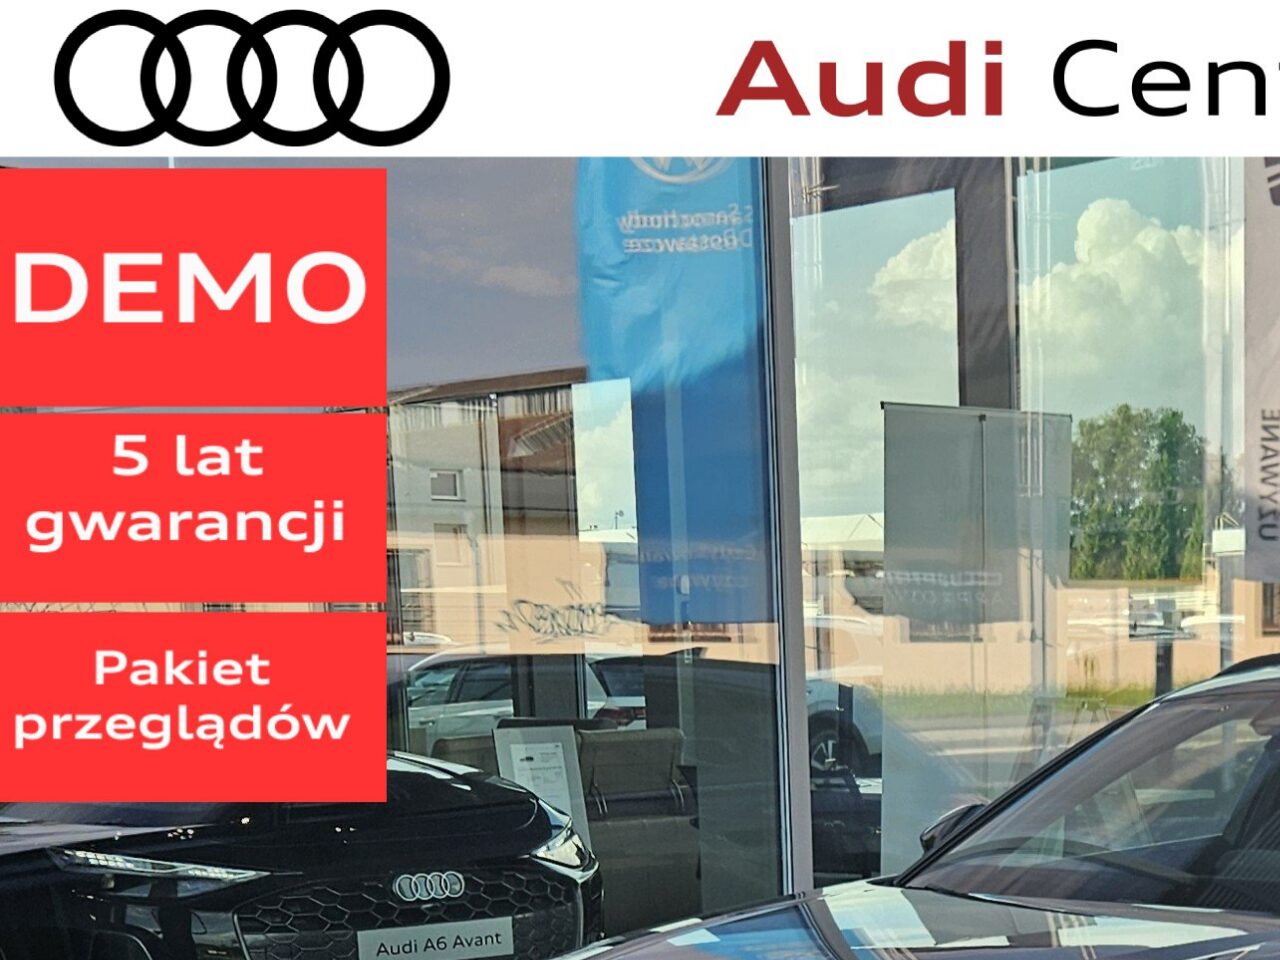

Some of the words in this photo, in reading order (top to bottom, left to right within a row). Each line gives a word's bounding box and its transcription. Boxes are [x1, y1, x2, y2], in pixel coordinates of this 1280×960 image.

[376, 939, 418, 957] Audi
[423, 936, 447, 952] A6
[453, 932, 502, 949] Avant
